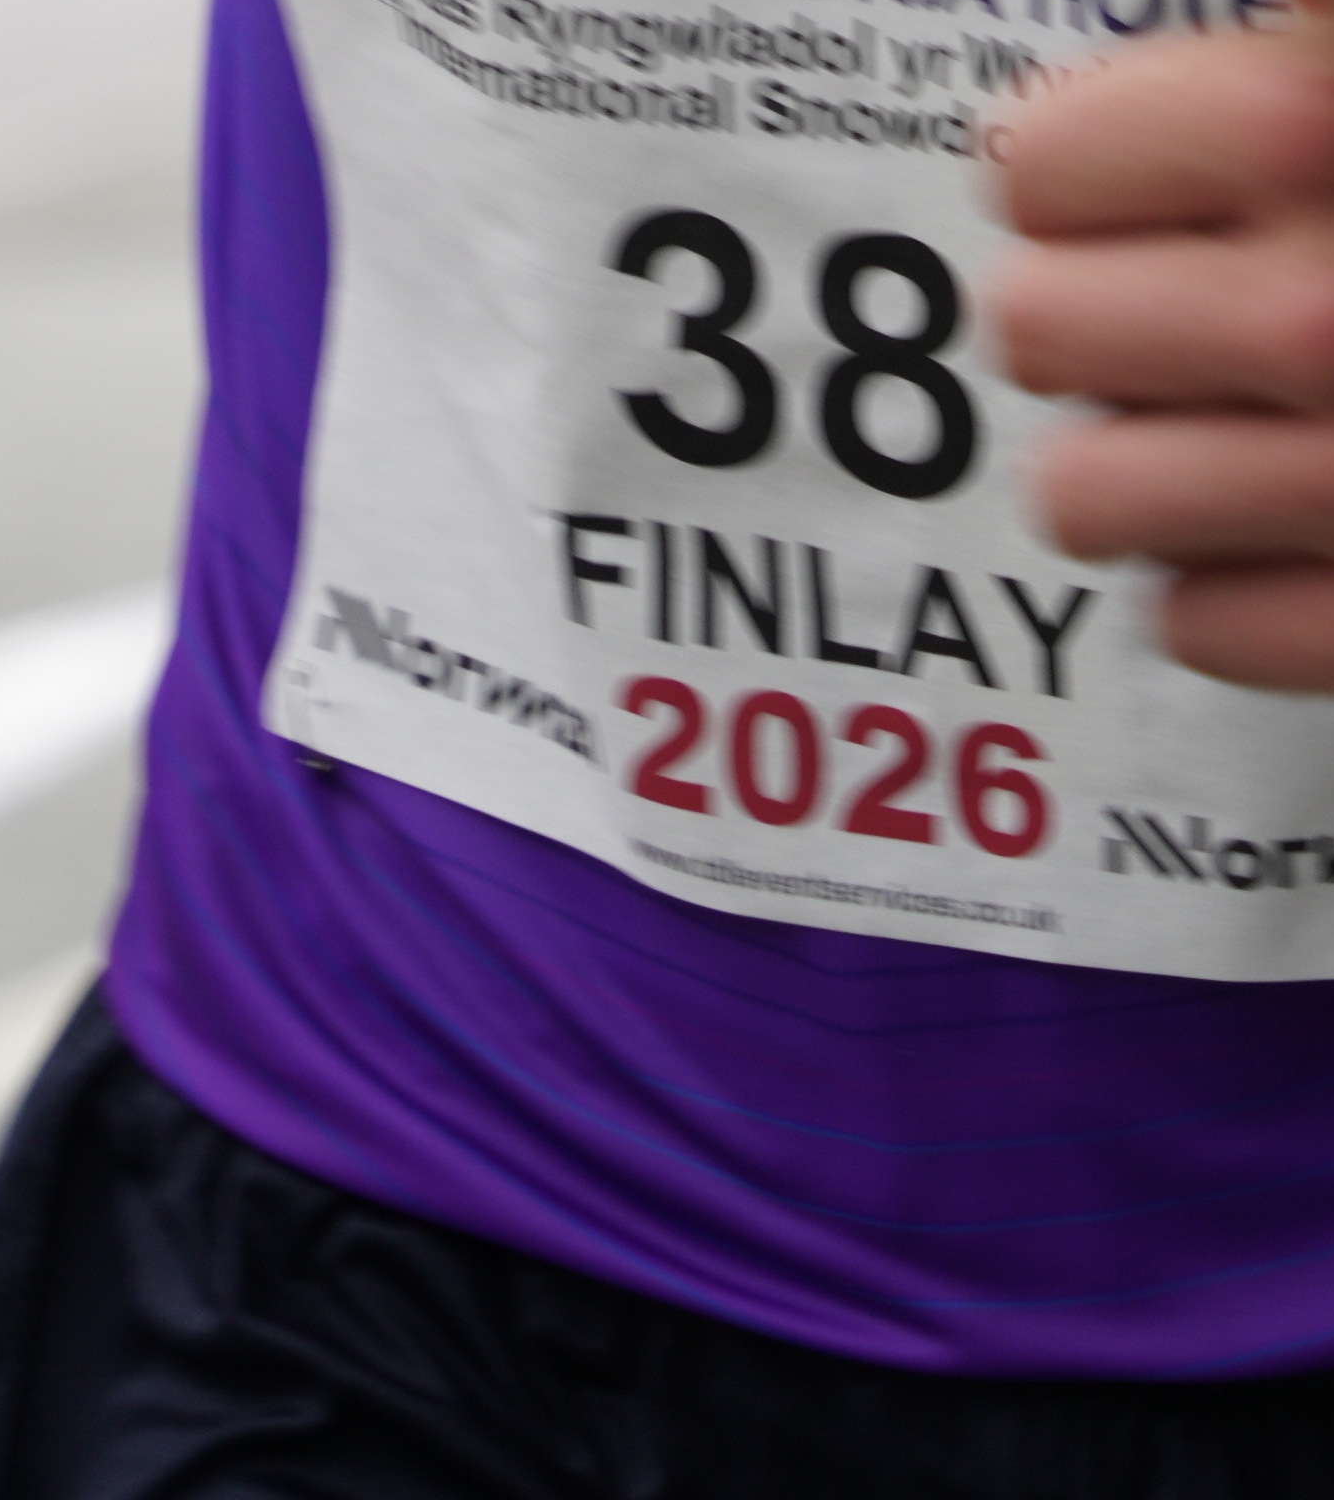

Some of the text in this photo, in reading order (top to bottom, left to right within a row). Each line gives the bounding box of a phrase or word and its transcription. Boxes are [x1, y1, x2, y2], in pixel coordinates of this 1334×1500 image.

[747, 80, 1023, 168] Snowdo
[605, 206, 987, 500] 38
[555, 506, 1101, 700] FINLAY
[617, 674, 1055, 860] 2026
